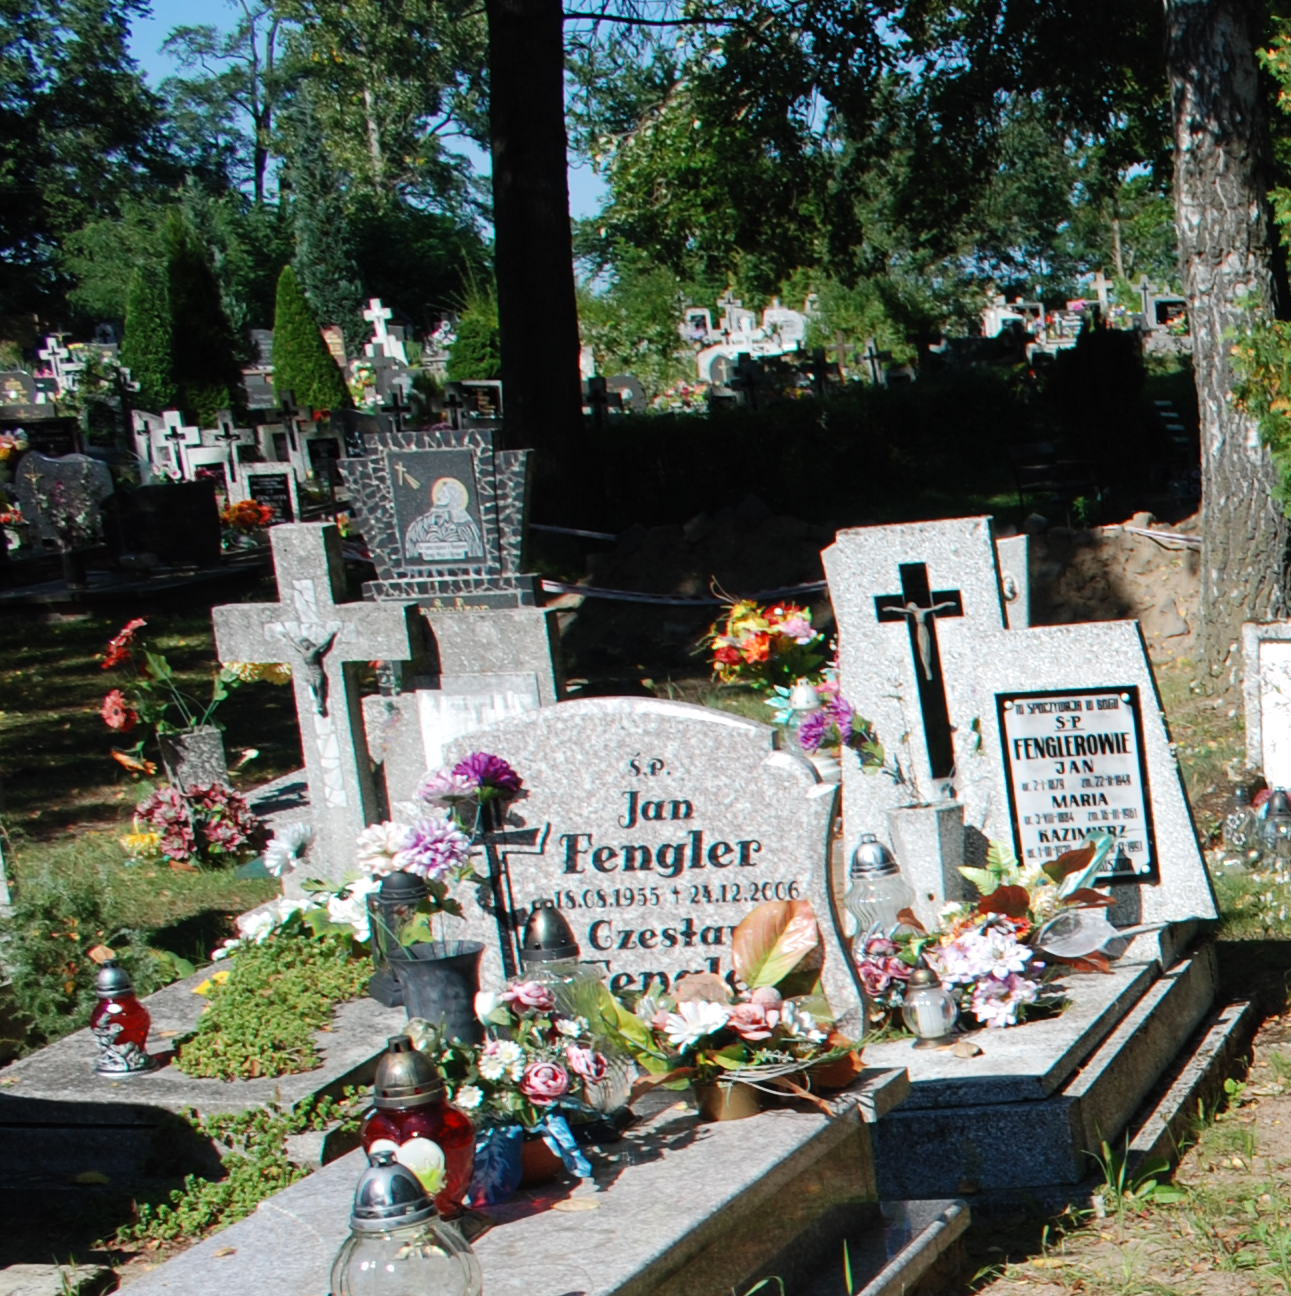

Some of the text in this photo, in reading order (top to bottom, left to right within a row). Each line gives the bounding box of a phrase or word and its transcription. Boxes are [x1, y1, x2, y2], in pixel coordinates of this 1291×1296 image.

[1013, 732, 1132, 760] FENGLEROWIE
[1055, 759, 1095, 775] JAN
[617, 790, 695, 829] Jan
[1052, 792, 1108, 808] MARIA
[559, 830, 762, 878] Fengler
[588, 918, 738, 951] Czesła
